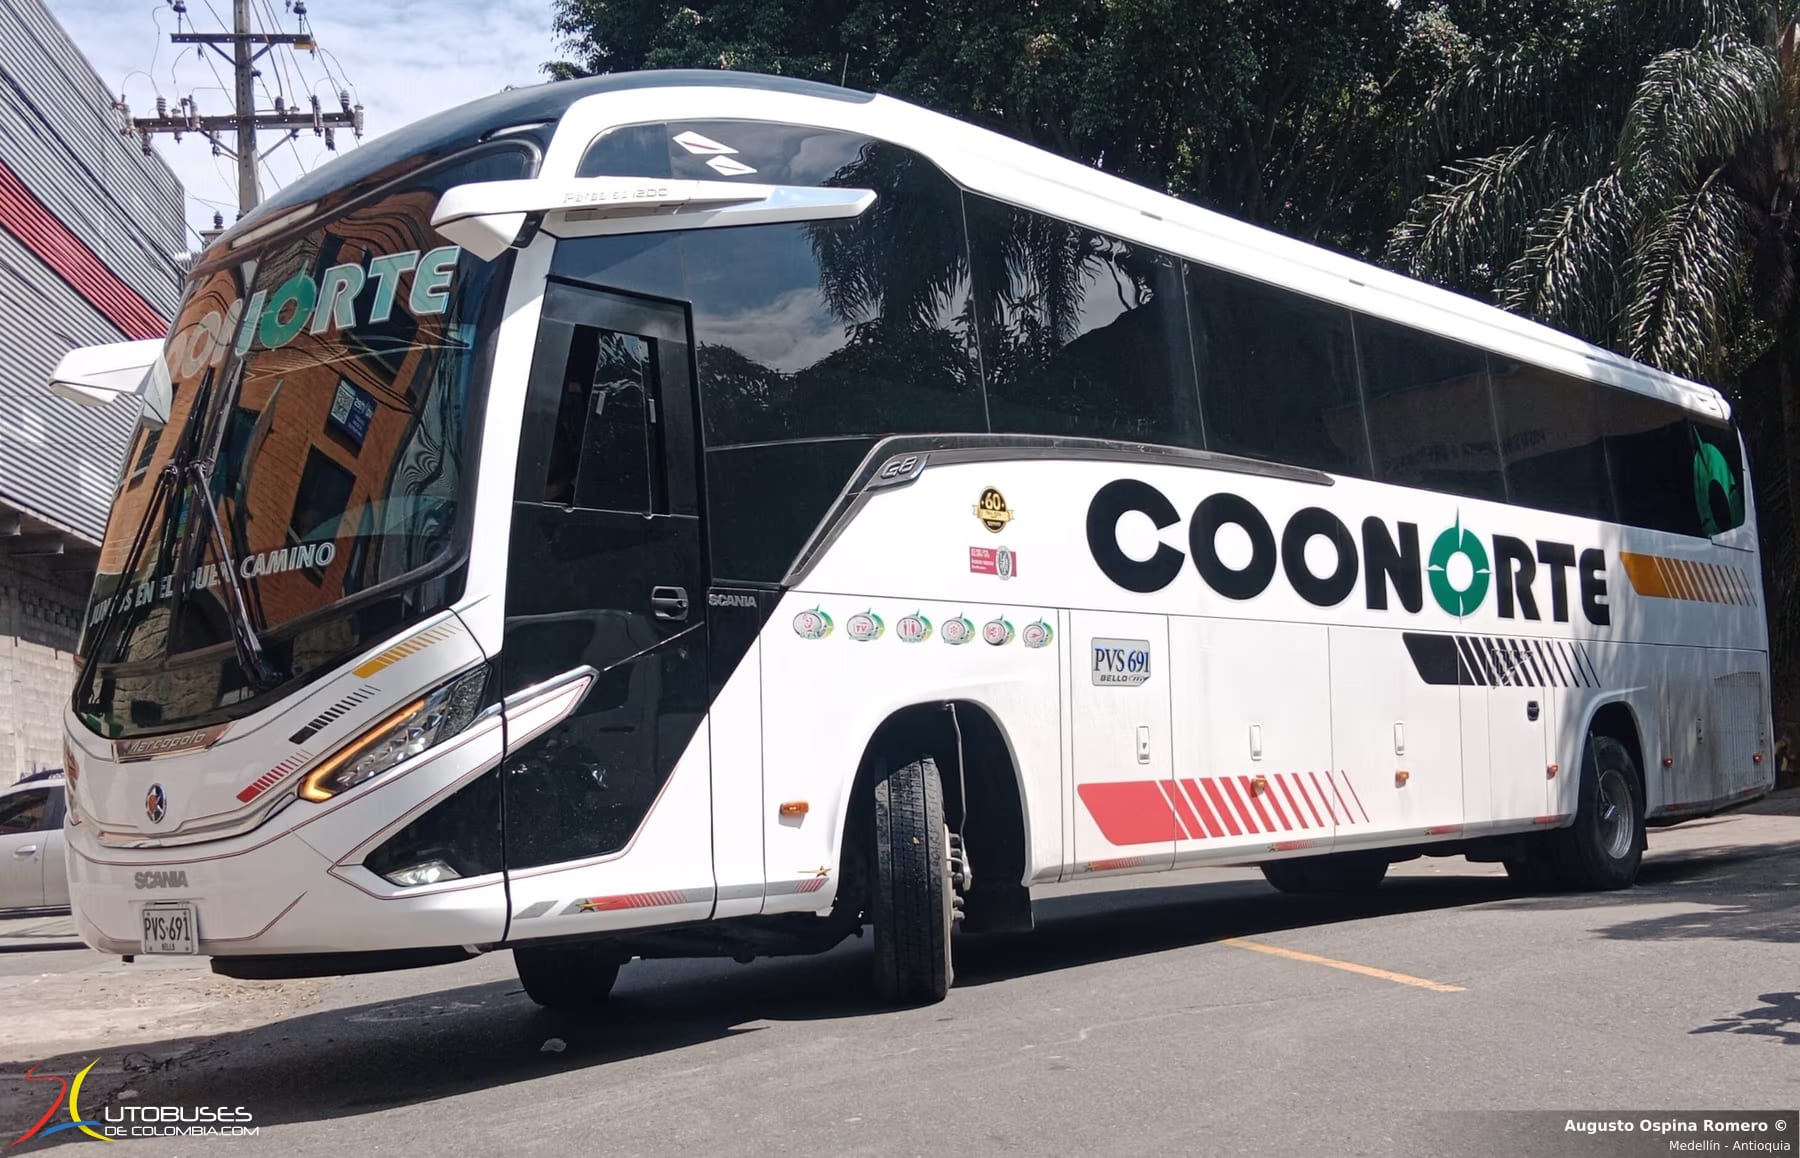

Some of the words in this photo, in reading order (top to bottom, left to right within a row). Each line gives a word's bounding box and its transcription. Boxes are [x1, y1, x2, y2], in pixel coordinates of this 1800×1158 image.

[881, 456, 917, 478] G8
[984, 492, 1002, 510] 60
[240, 542, 336, 578] CAMINO
[1086, 478, 1610, 625] COONORTE
[708, 593, 758, 608] SCANIA
[1094, 648, 1125, 672] PVS
[1127, 650, 1149, 672] 691
[1100, 674, 1128, 682] BELLO
[134, 871, 189, 889] SCANIA
